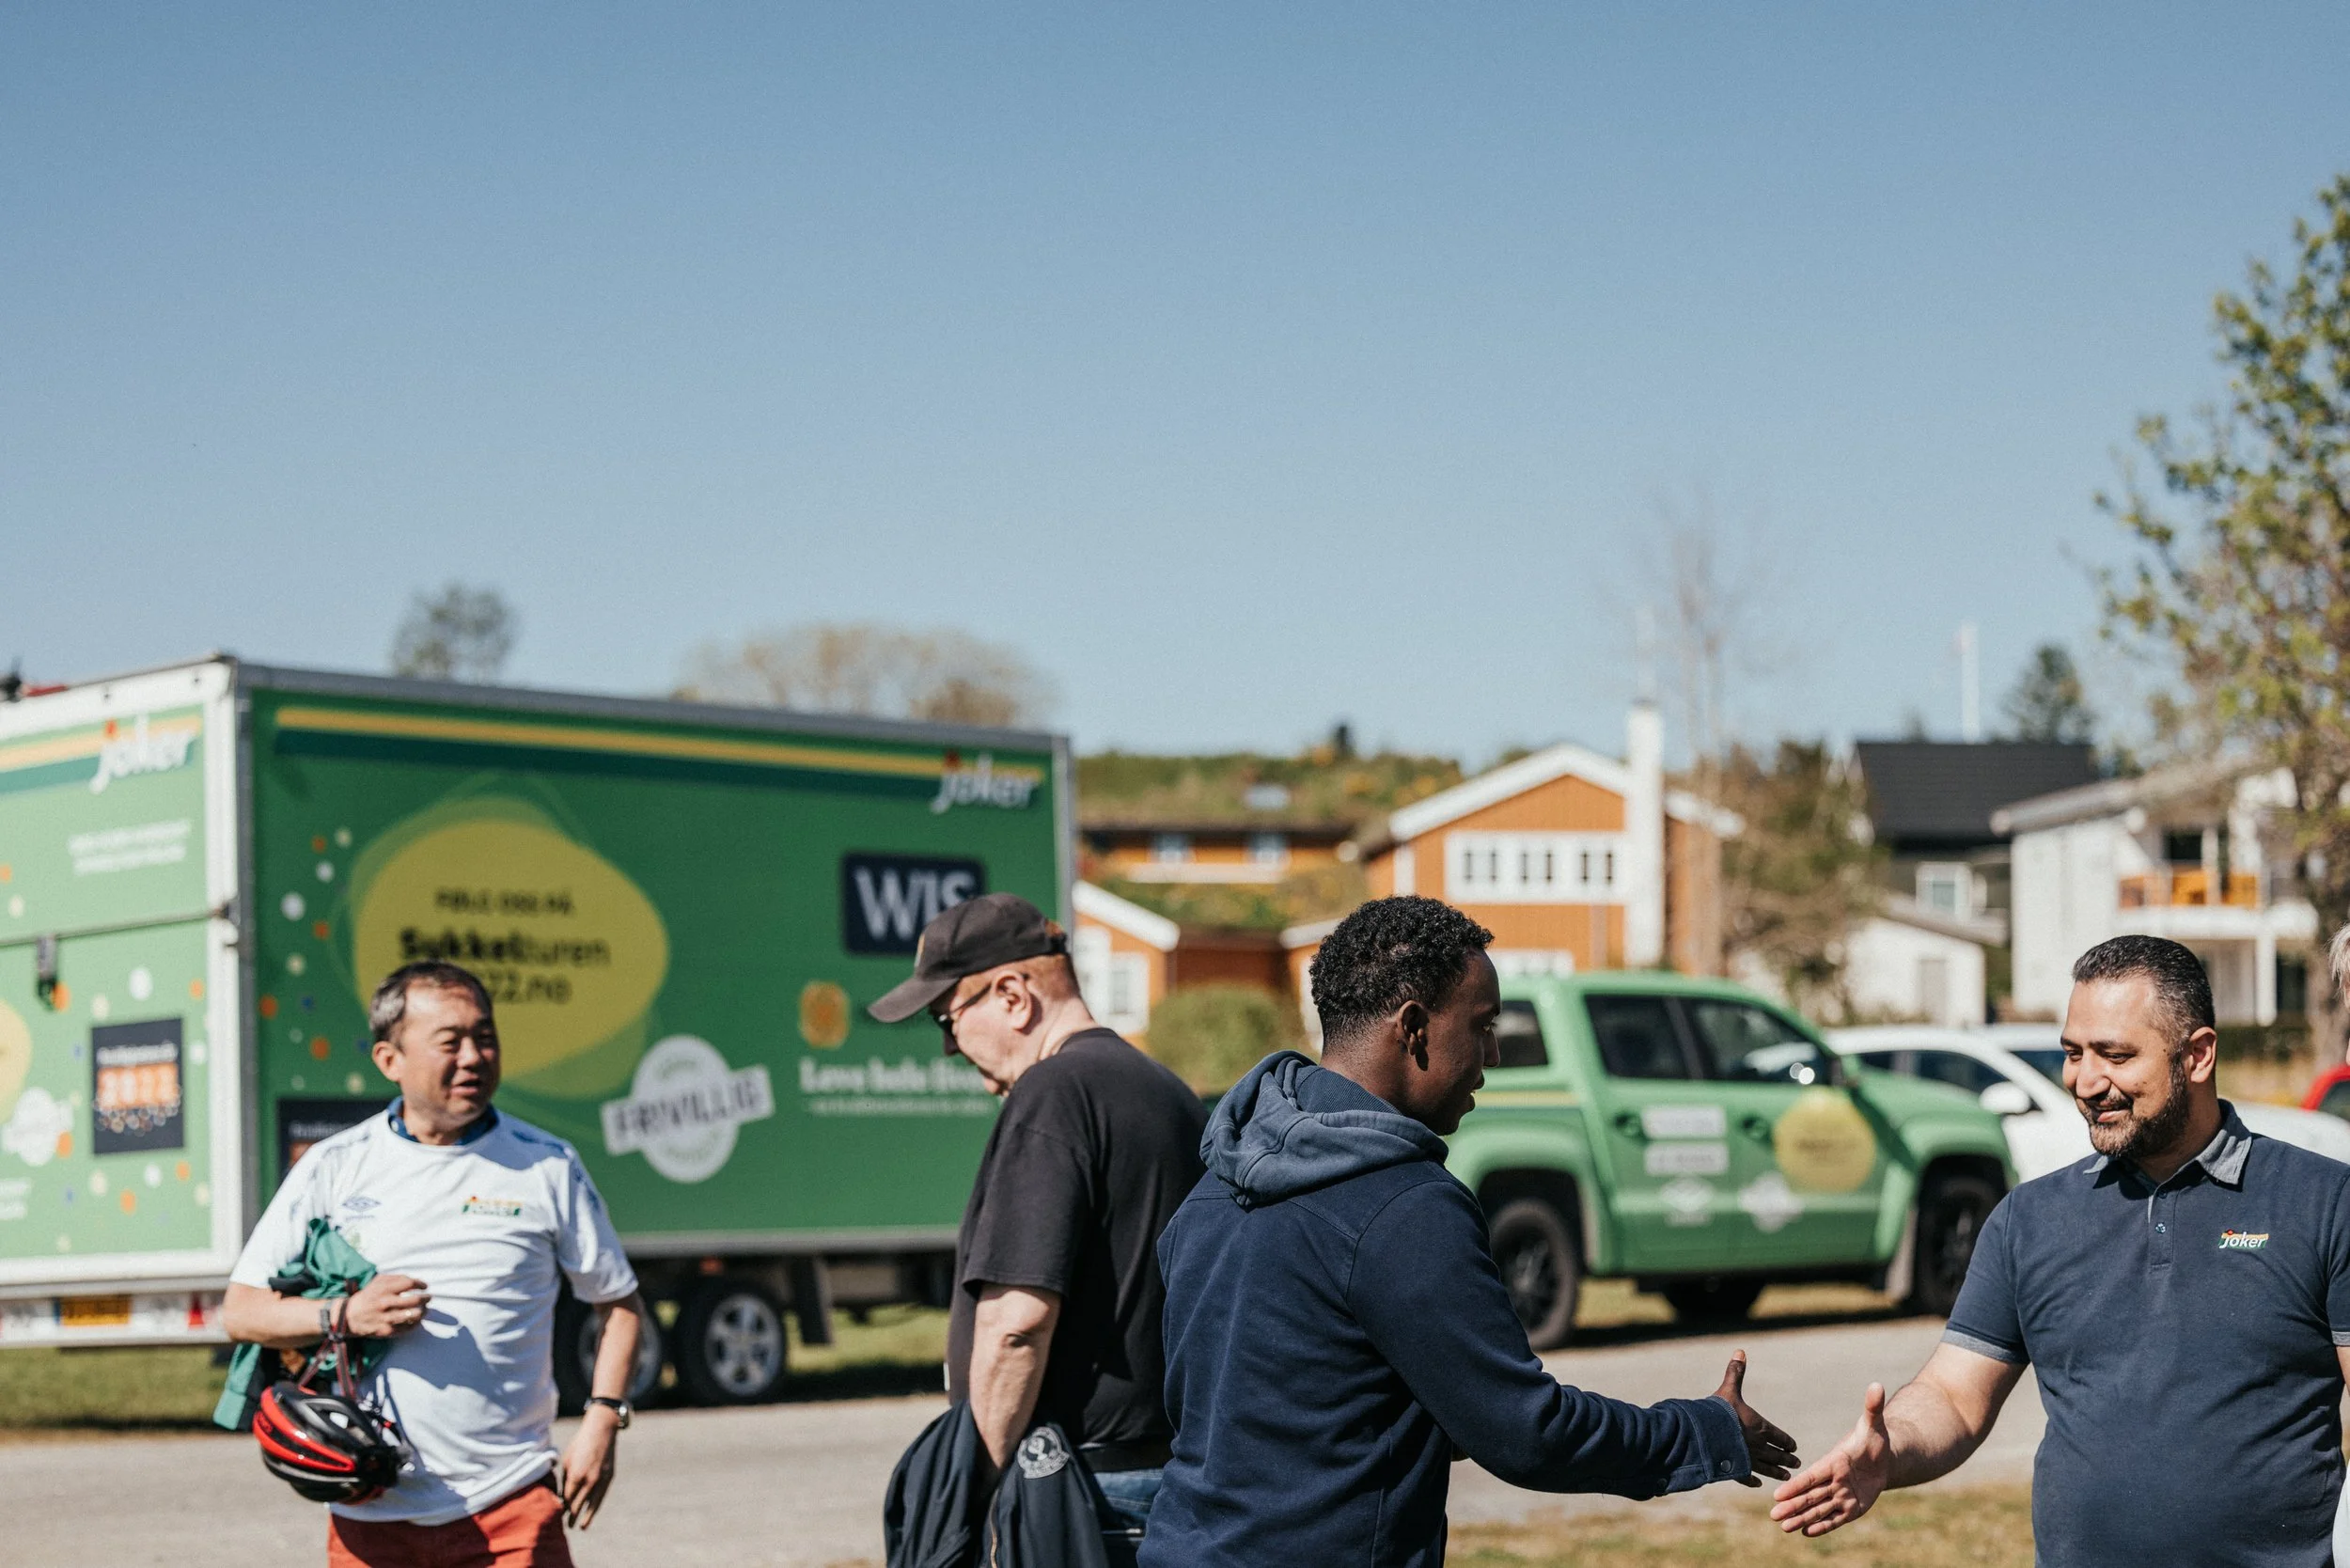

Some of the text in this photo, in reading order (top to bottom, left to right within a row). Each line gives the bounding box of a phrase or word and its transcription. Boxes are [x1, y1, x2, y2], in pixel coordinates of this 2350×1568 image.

[90, 715, 194, 792] joker
[930, 750, 1035, 813] joker
[613, 1074, 762, 1143] FRIVILLIG
[2219, 1230, 2266, 1249] joker
